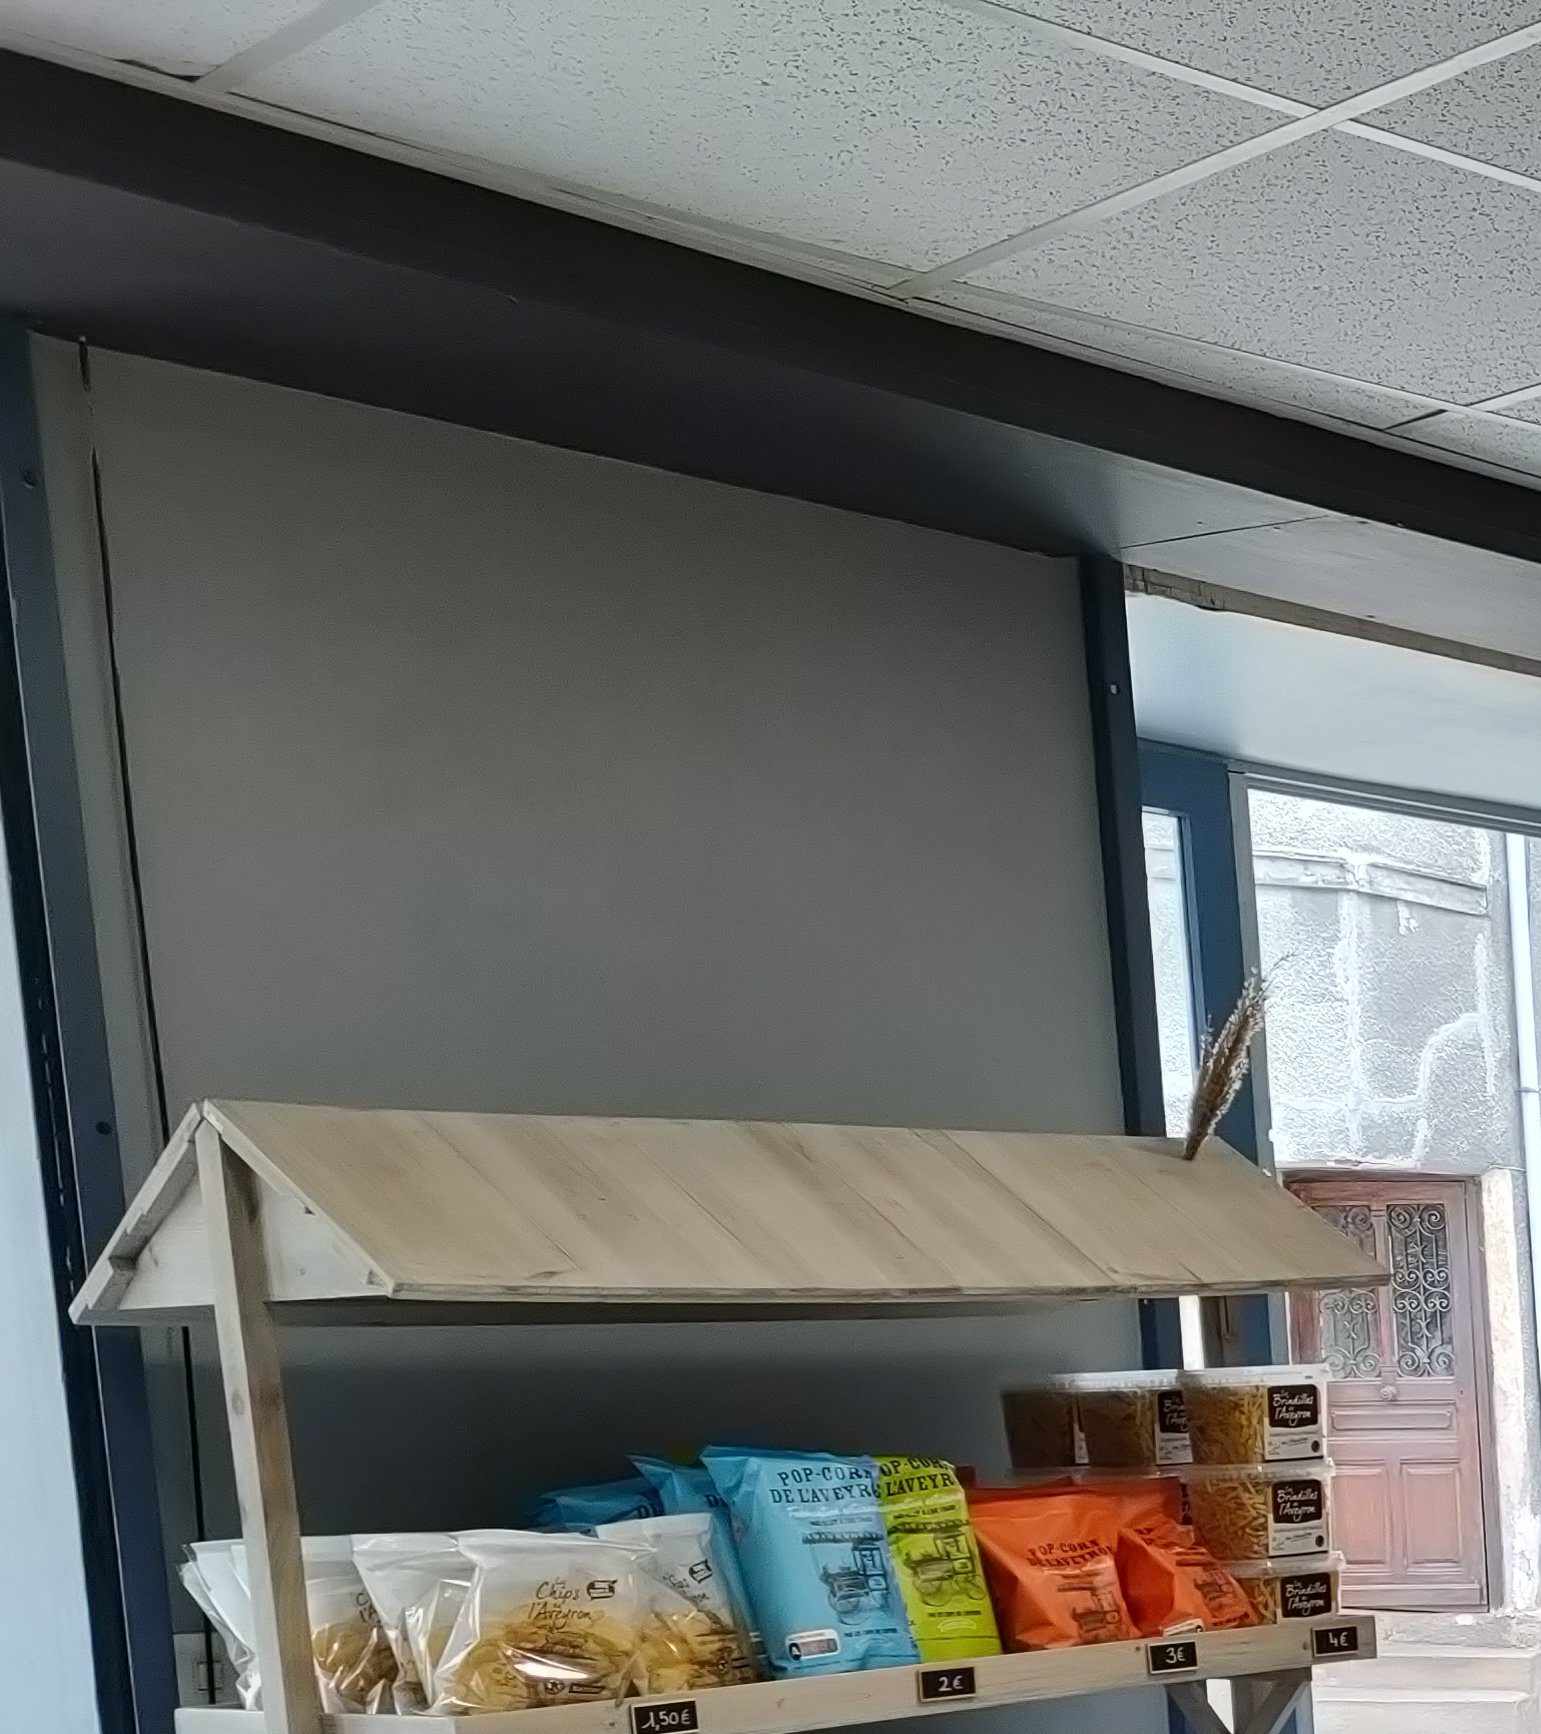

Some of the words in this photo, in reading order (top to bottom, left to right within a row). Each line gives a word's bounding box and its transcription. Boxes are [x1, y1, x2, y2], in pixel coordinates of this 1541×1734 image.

[770, 1489, 794, 1504] DE
[536, 1581, 580, 1605] Chips
[1328, 1631, 1349, 1647] 4€
[1166, 1647, 1185, 1663] 3€
[937, 1675, 964, 1693] 2€
[641, 1709, 691, 1730] 1,50€
